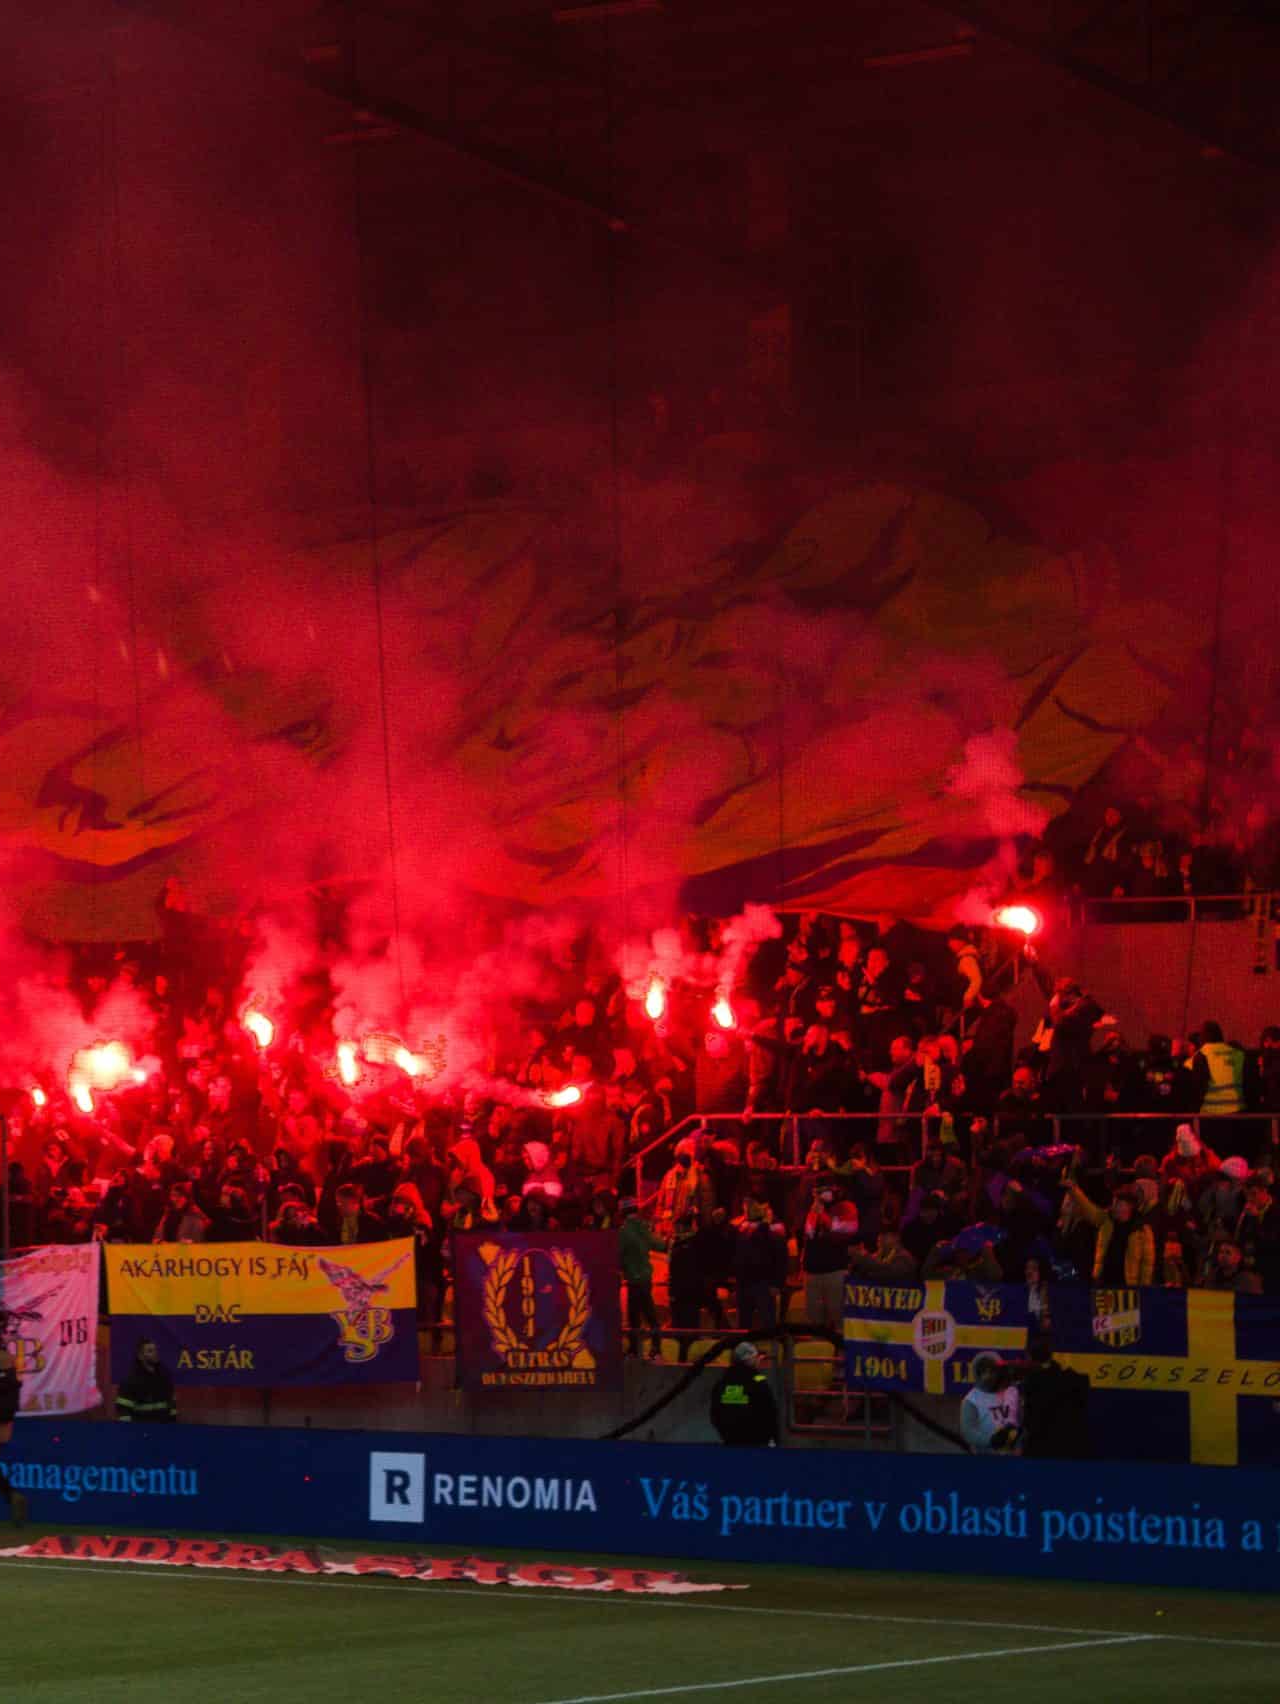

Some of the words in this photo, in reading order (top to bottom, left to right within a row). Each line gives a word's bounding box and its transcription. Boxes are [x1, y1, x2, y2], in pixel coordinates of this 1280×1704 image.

[120, 1254, 243, 1279] AKÁRHOGY
[249, 1257, 267, 1277] IS
[845, 1284, 924, 1310] NEGYED
[194, 1304, 243, 1324] DAC
[177, 1348, 193, 1369] A
[506, 1351, 570, 1368] ULTRAS
[852, 1353, 908, 1381] 1904
[988, 1405, 1010, 1420] TV
[383, 1469, 411, 1505] R
[434, 1474, 598, 1512] RENOMIA
[640, 1477, 710, 1521] Váš
[721, 1491, 851, 1537] partner
[864, 1501, 889, 1530] v
[898, 1491, 1028, 1538] oblasti
[1040, 1497, 1228, 1553] poistenia
[1240, 1518, 1264, 1553] a
[22, 1535, 322, 1573] ANDREA
